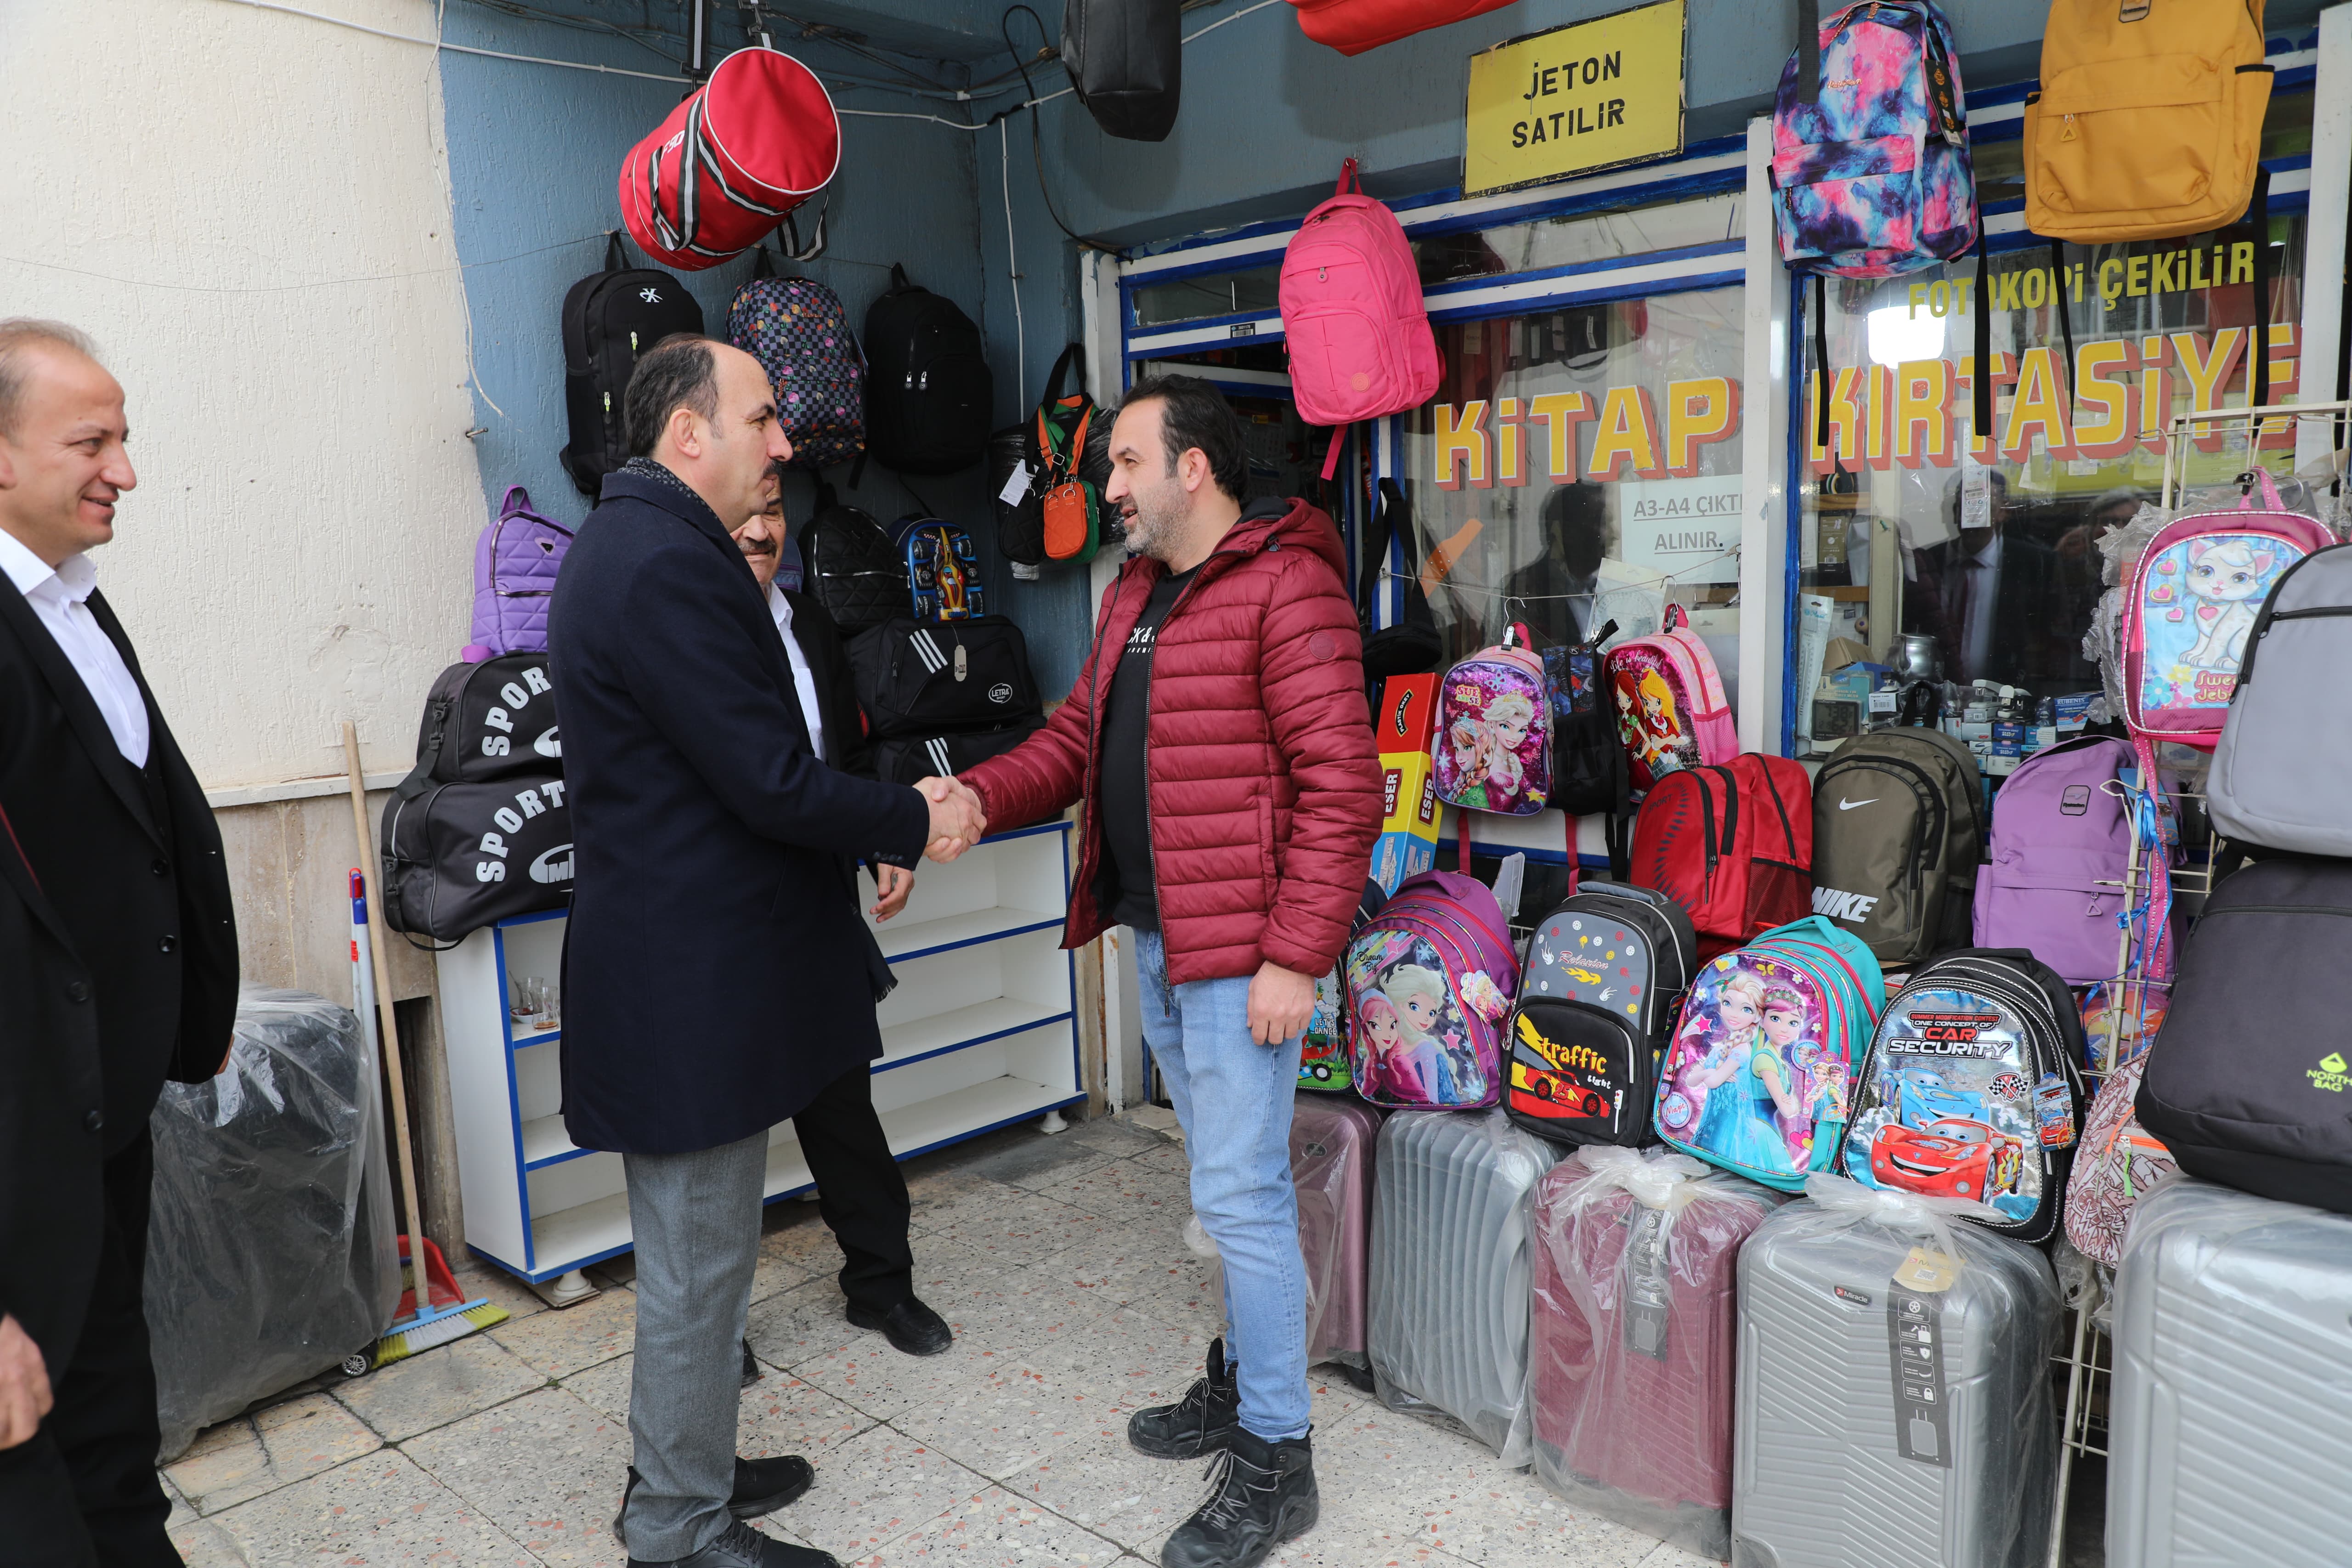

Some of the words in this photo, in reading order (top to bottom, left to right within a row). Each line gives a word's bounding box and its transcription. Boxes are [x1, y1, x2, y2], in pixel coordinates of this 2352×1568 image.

[1511, 98, 1625, 148] SATILIR
[1634, 498, 1690, 517] A3-A4
[1655, 531, 1724, 550] ALINIR.
[1610, 657, 1624, 674] Life
[1626, 654, 1631, 663] is
[1634, 650, 1663, 669] beautiful
[991, 688, 1010, 697] LETRA
[1457, 686, 1478, 697] SUE
[1469, 696, 1479, 705] SE
[2198, 688, 2232, 700] Jeb
[482, 662, 552, 756] SPOR
[1400, 693, 1410, 709] OKEY
[1396, 709, 1405, 733] PLASTİK
[1421, 778, 1434, 820] ESER
[1647, 793, 1673, 813] SPORT
[476, 780, 566, 883] SPORT
[1811, 886, 1879, 923] NIKE
[1357, 951, 1383, 962] Dream
[1315, 1018, 1335, 1026] LET'S
[1314, 1027, 1337, 1036] DANCE
[1925, 1027, 1977, 1041] CAR
[1540, 1037, 1607, 1075] traffic
[1889, 1039, 2009, 1057] SECURITY
[2306, 1069, 2352, 1087] NORTH
[2312, 1079, 2343, 1093] BAG
[1555, 1082, 1571, 1100] 25
[2035, 1092, 2070, 1105] SECURITY
[1666, 1103, 1686, 1118] Magic
[1843, 1291, 1868, 1303] Miracle
